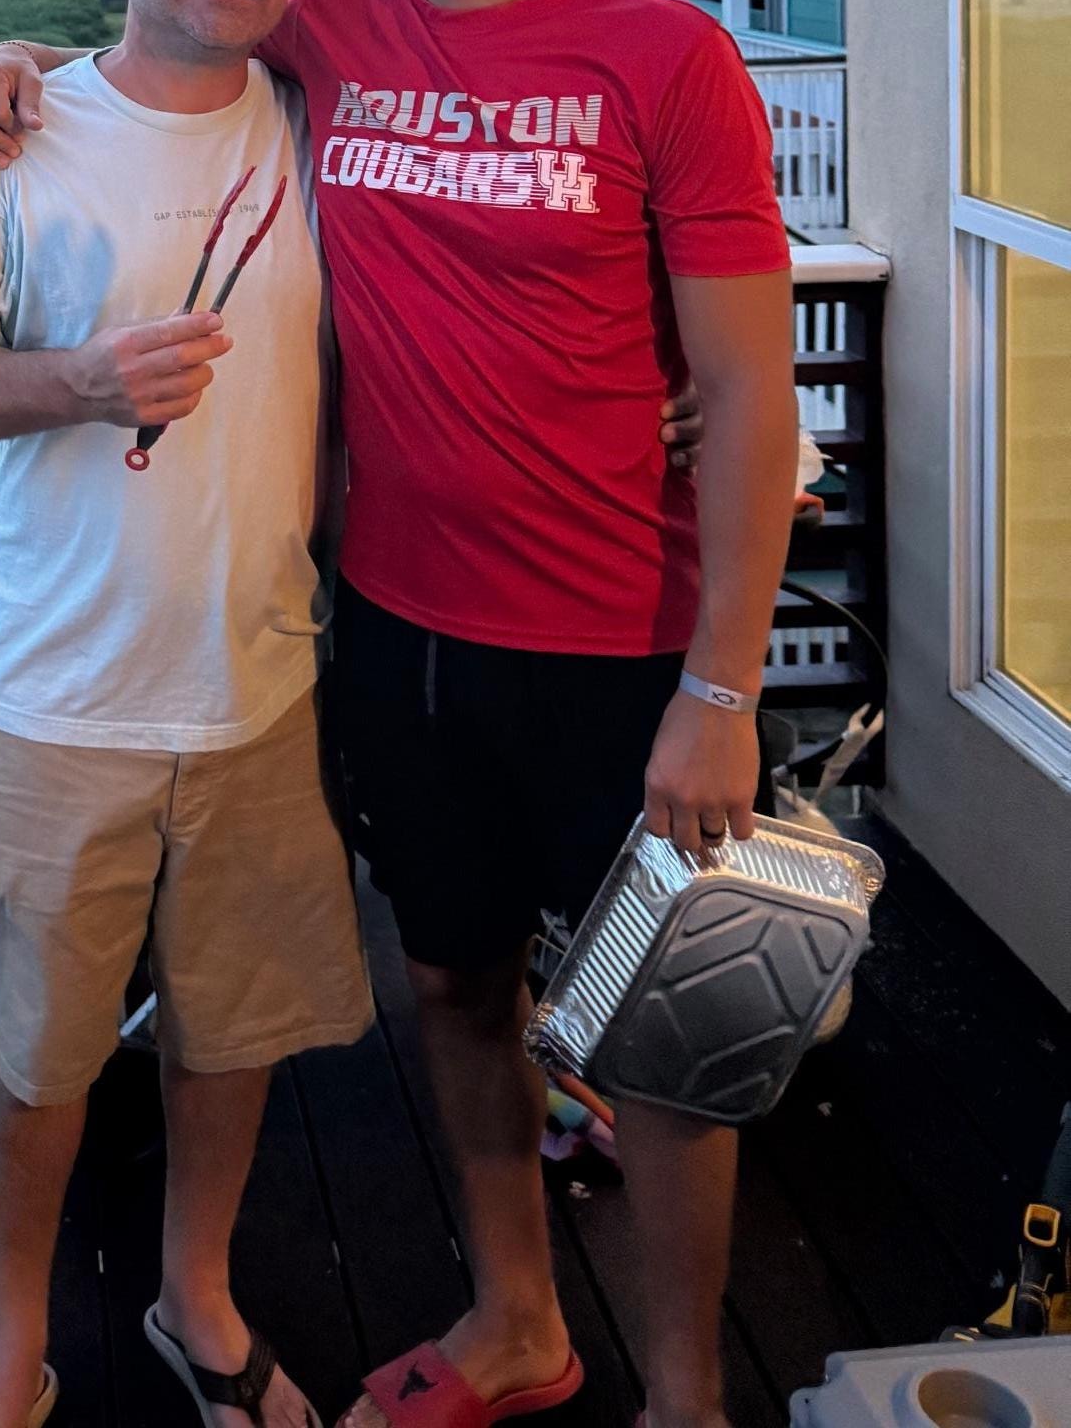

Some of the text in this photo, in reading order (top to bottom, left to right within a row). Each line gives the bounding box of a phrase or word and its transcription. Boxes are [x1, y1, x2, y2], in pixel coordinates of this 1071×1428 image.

[331, 80, 603, 147] HOUSTON
[320, 135, 535, 206] COUGARS
[534, 148, 598, 214] UH
[153, 211, 170, 221] GAP
[176, 208, 221, 220] ESTABLIS
